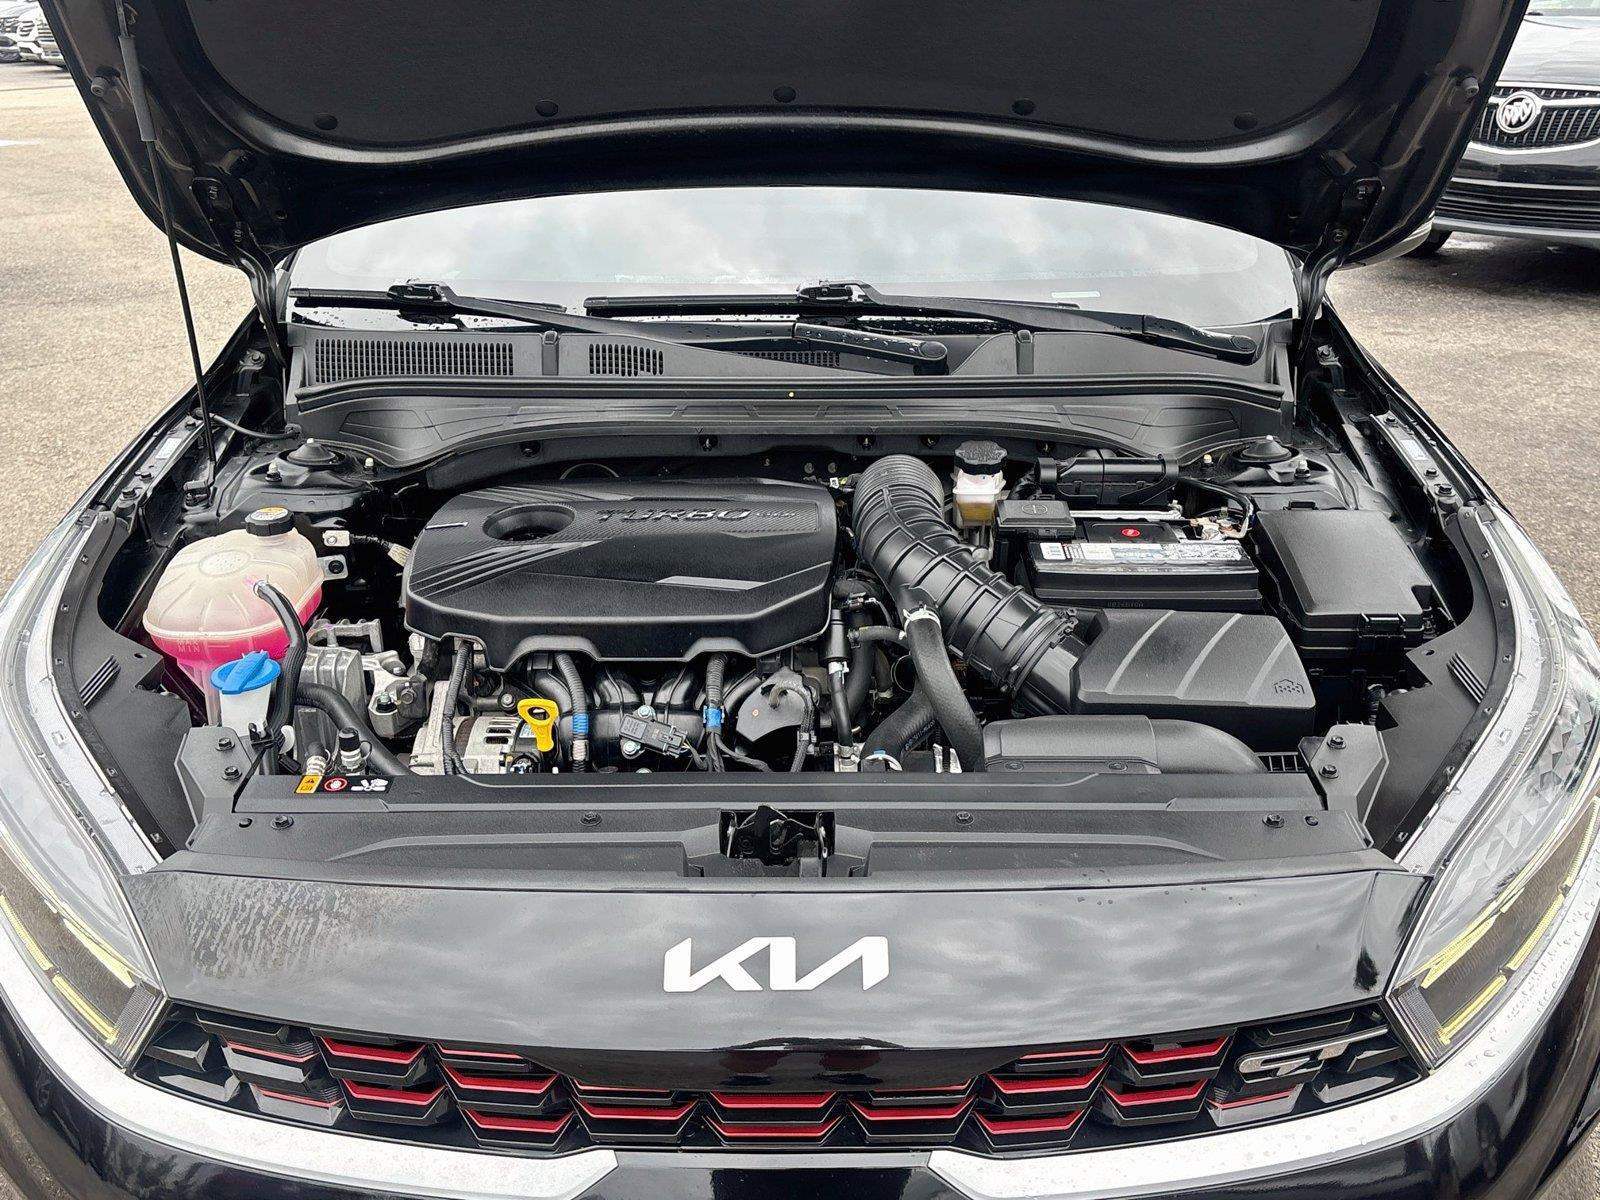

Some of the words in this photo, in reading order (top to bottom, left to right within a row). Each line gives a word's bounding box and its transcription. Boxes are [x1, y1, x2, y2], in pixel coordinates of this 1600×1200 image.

[596, 508, 751, 522] TURBO
[663, 936, 890, 993] KIA
[1236, 1024, 1389, 1077] GT
